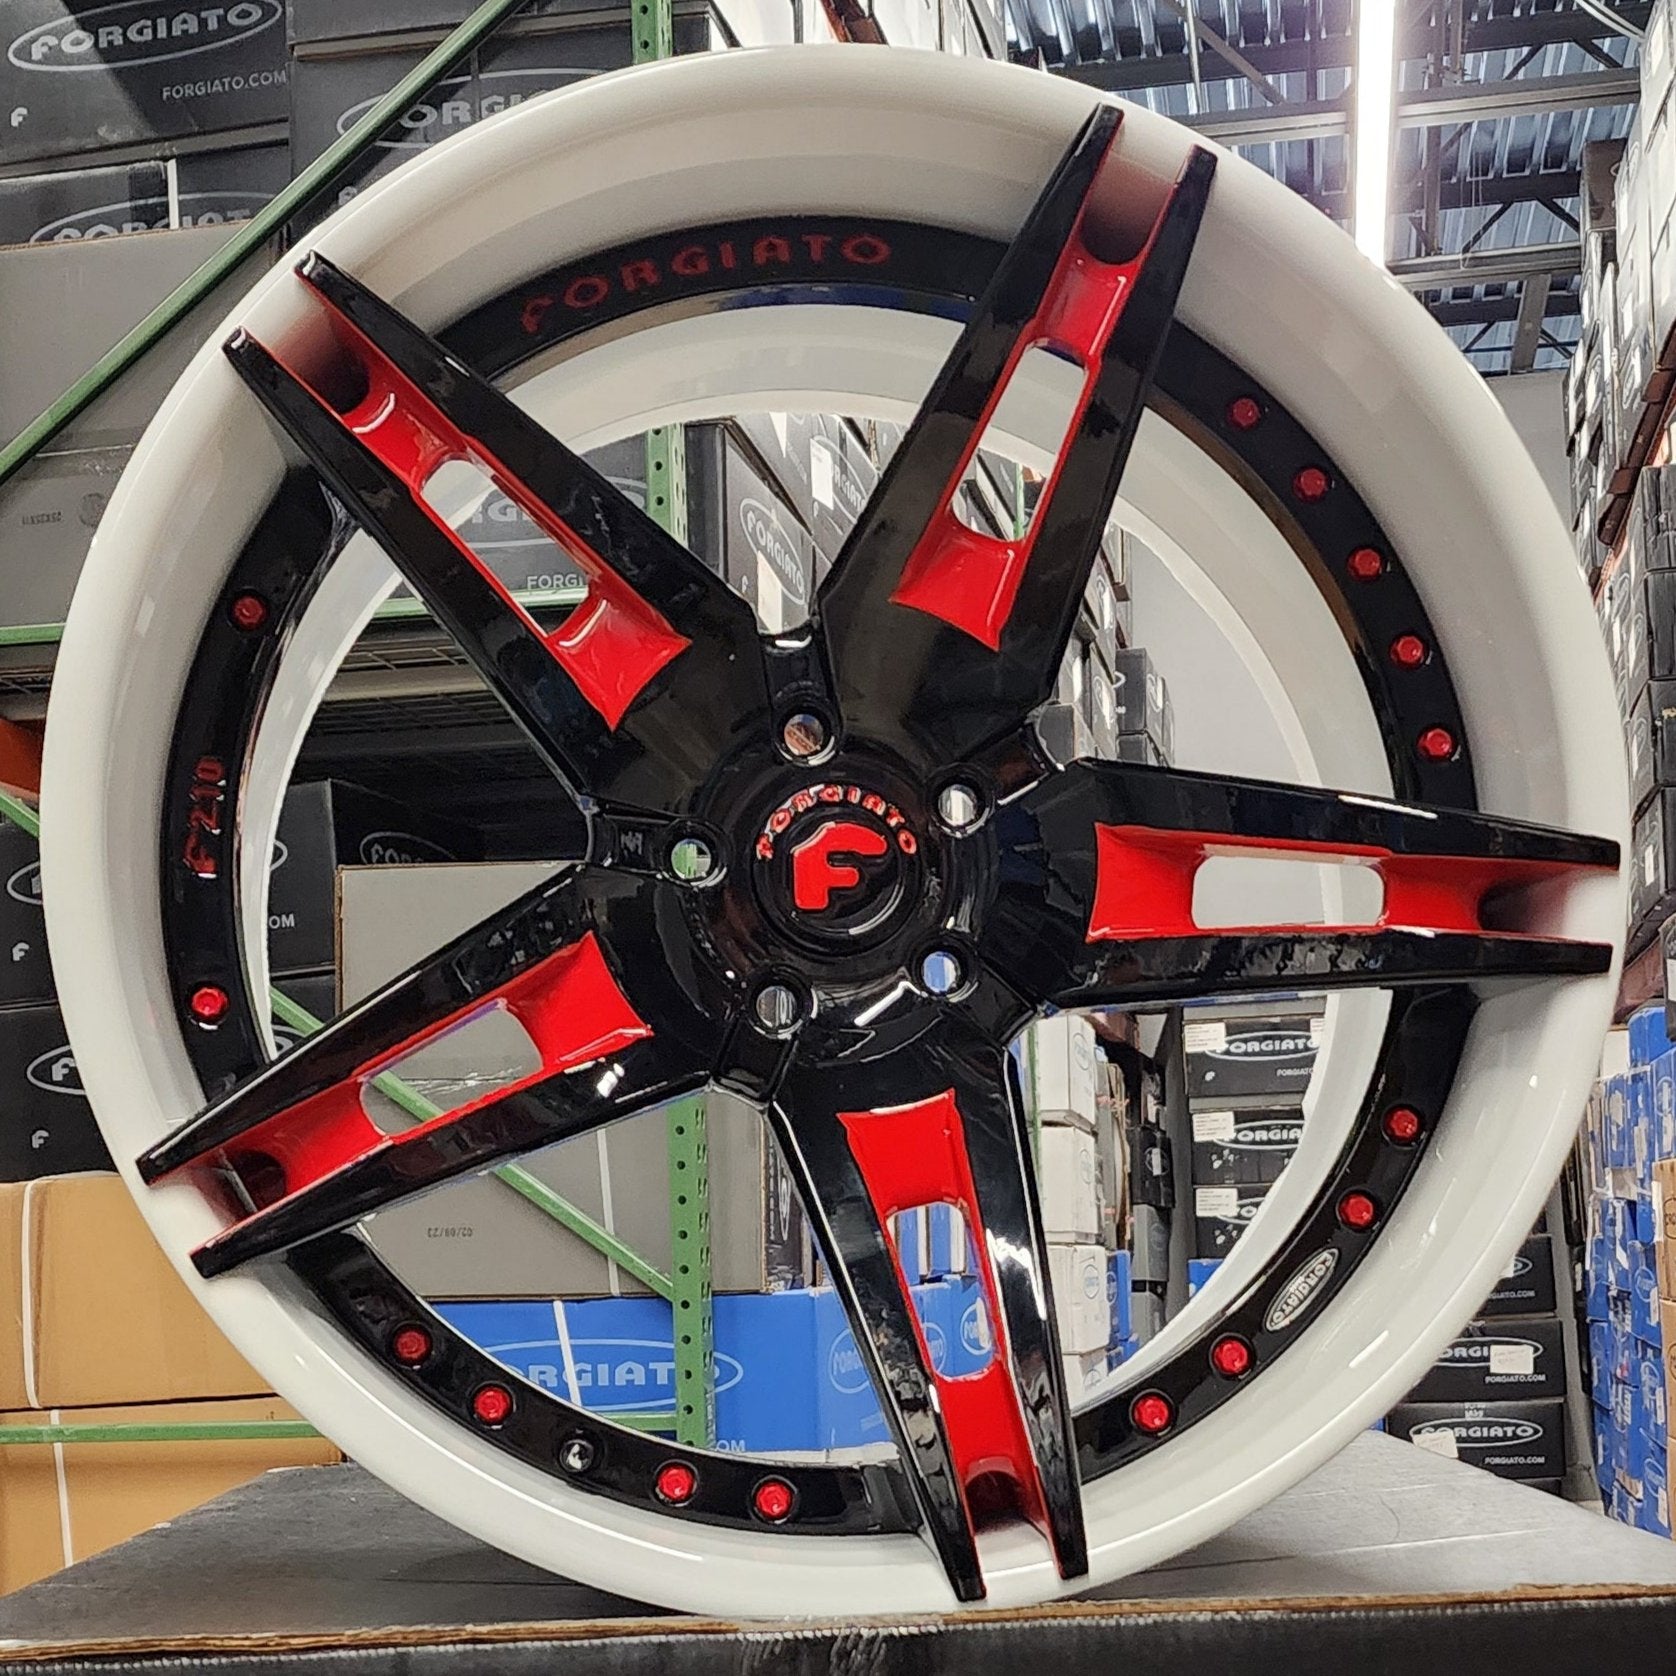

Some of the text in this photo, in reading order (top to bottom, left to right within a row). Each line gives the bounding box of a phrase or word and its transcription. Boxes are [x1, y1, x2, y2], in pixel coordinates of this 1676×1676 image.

[31, 3, 263, 61] FORGIATO
[10, 107, 28, 127] F
[162, 69, 287, 101] FORGIATO.COM
[521, 233, 892, 335] FORGIATO
[746, 510, 805, 594] FORGIATO
[756, 783, 917, 860] FORGIATO
[791, 821, 888, 911] F
[12, 942, 29, 961] F
[32, 1129, 49, 1148] F
[1272, 1253, 1333, 1323] FORGIATO
